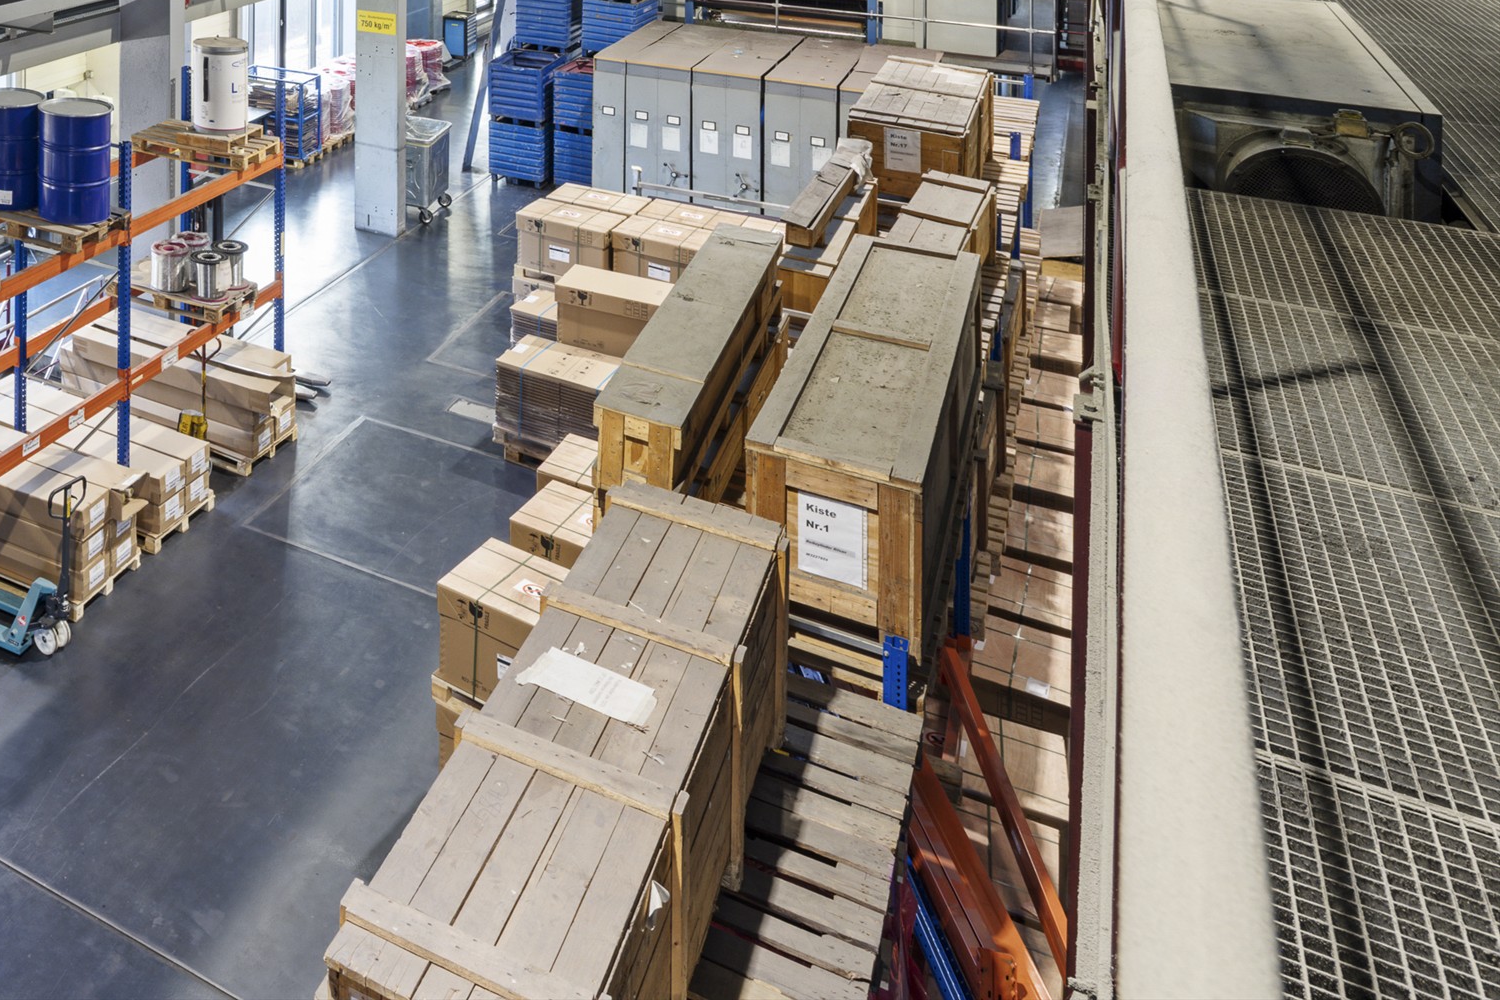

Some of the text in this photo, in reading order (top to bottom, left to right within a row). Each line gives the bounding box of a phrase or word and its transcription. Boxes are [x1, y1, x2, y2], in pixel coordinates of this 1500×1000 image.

[361, 19, 373, 28] 750
[806, 503, 837, 518] Kiste
[806, 519, 829, 532] Nr.1
